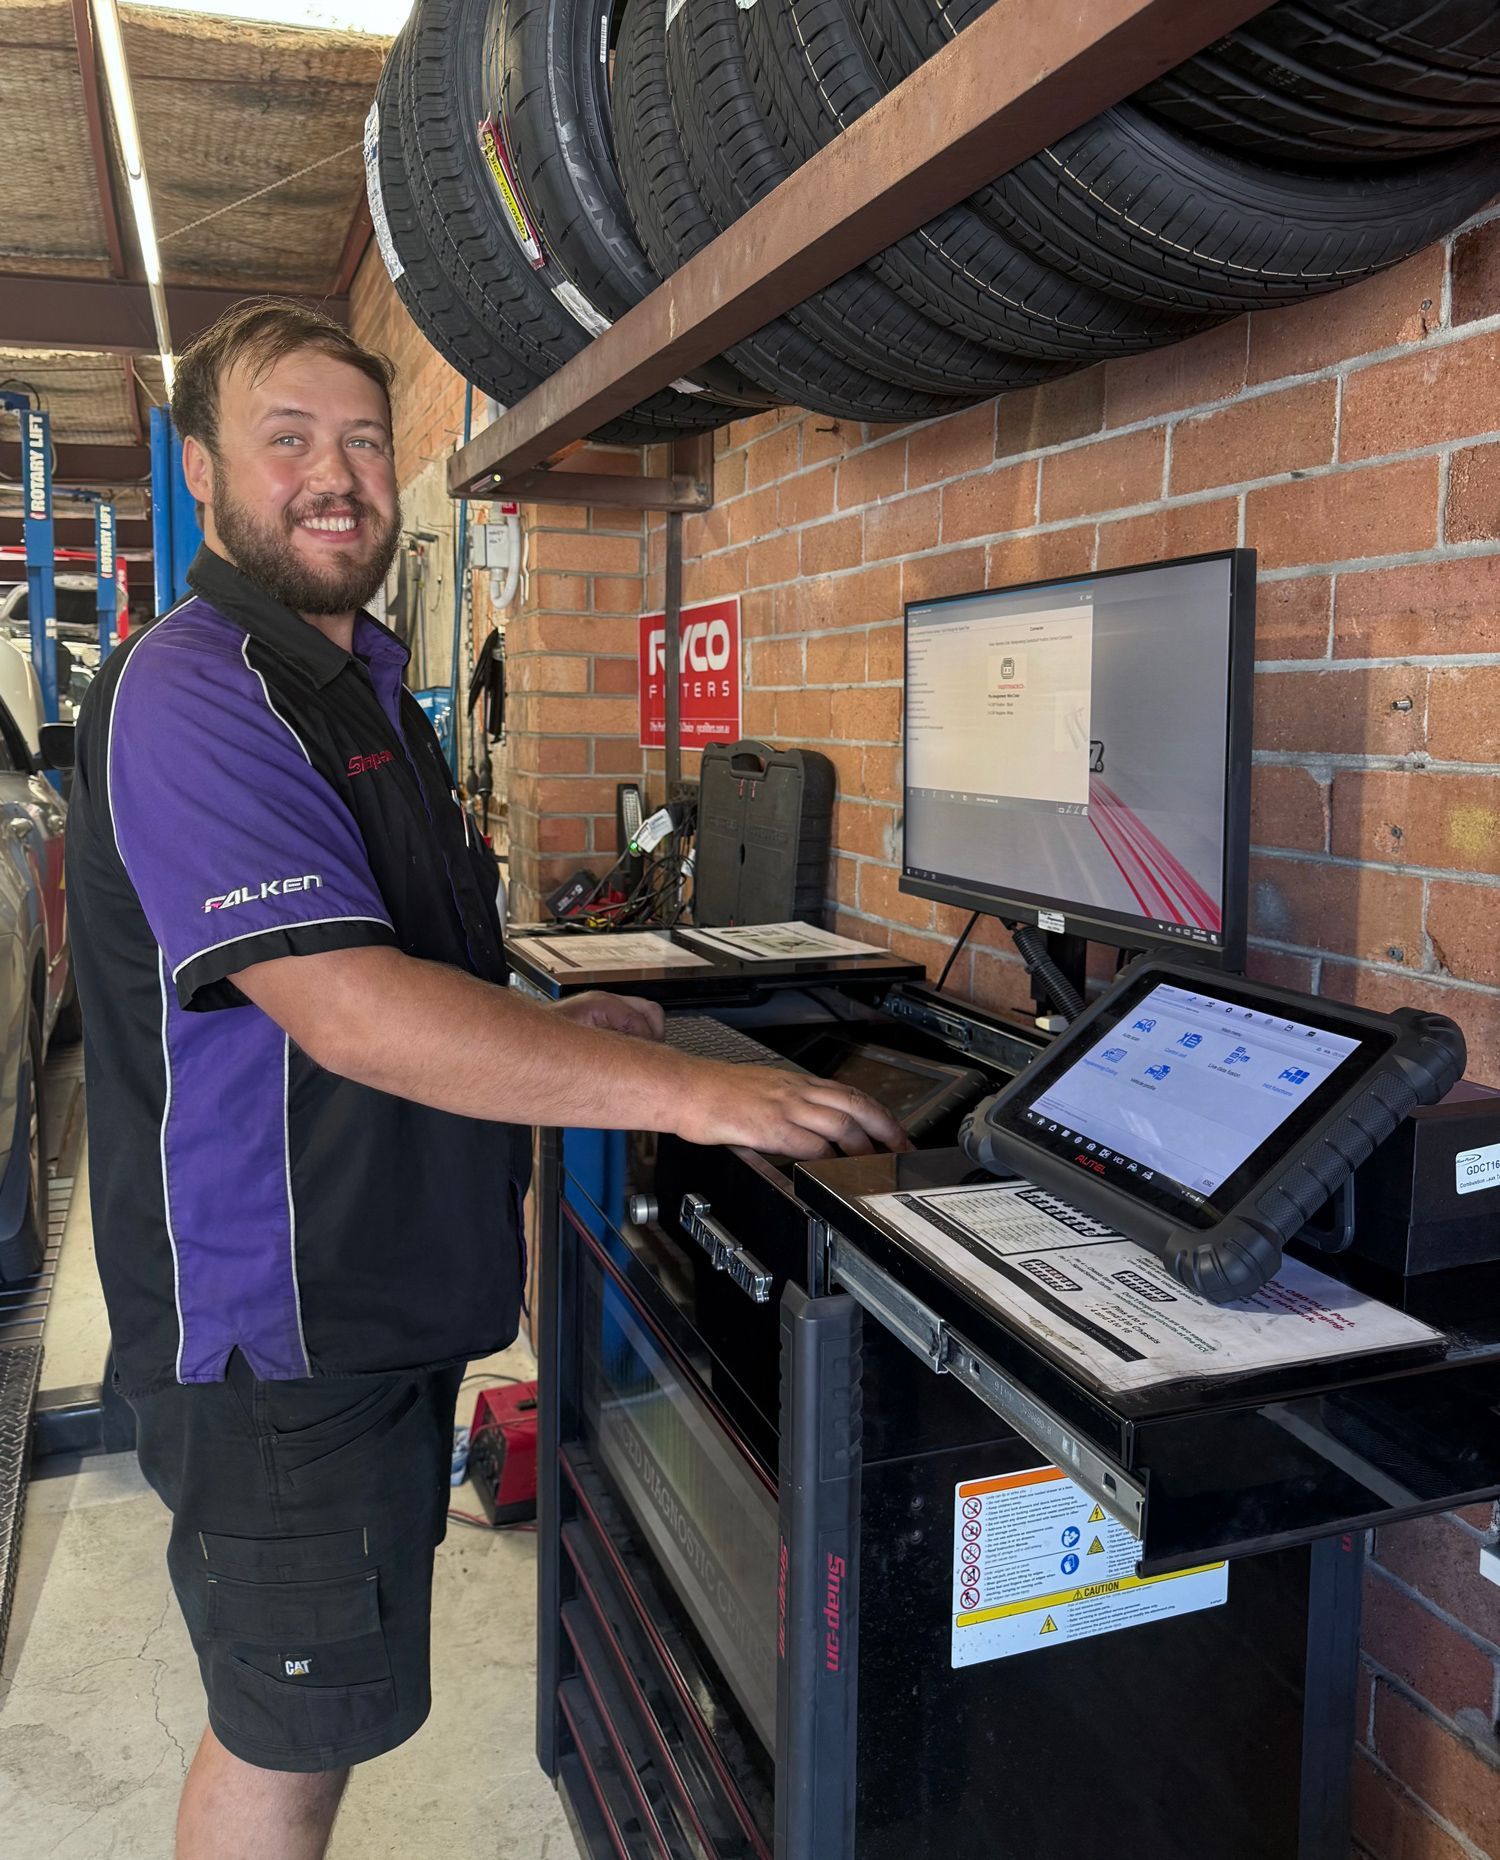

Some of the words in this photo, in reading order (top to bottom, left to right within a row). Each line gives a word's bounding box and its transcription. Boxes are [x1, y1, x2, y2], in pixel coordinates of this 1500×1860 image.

[28, 413, 45, 448] LIFT
[29, 449, 46, 513] ROTARY
[99, 504, 112, 530] LIFT
[100, 530, 113, 573] ROTARY
[649, 680, 730, 699] FITERS
[202, 874, 323, 913] FALKEN
[1074, 1154, 1106, 1175] AUTEL
[1466, 1160, 1500, 1176] GDCT16
[1111, 1305, 1127, 1314] Pins
[1132, 1325, 1160, 1343] Chassis
[642, 1453, 716, 1592] DIAGNOSTIC
[778, 1536, 788, 1660] Snap-on
[1084, 1580, 1120, 1597] CAUTION
[823, 1551, 846, 1672] Snap-on
[285, 1659, 312, 1676] CAT
